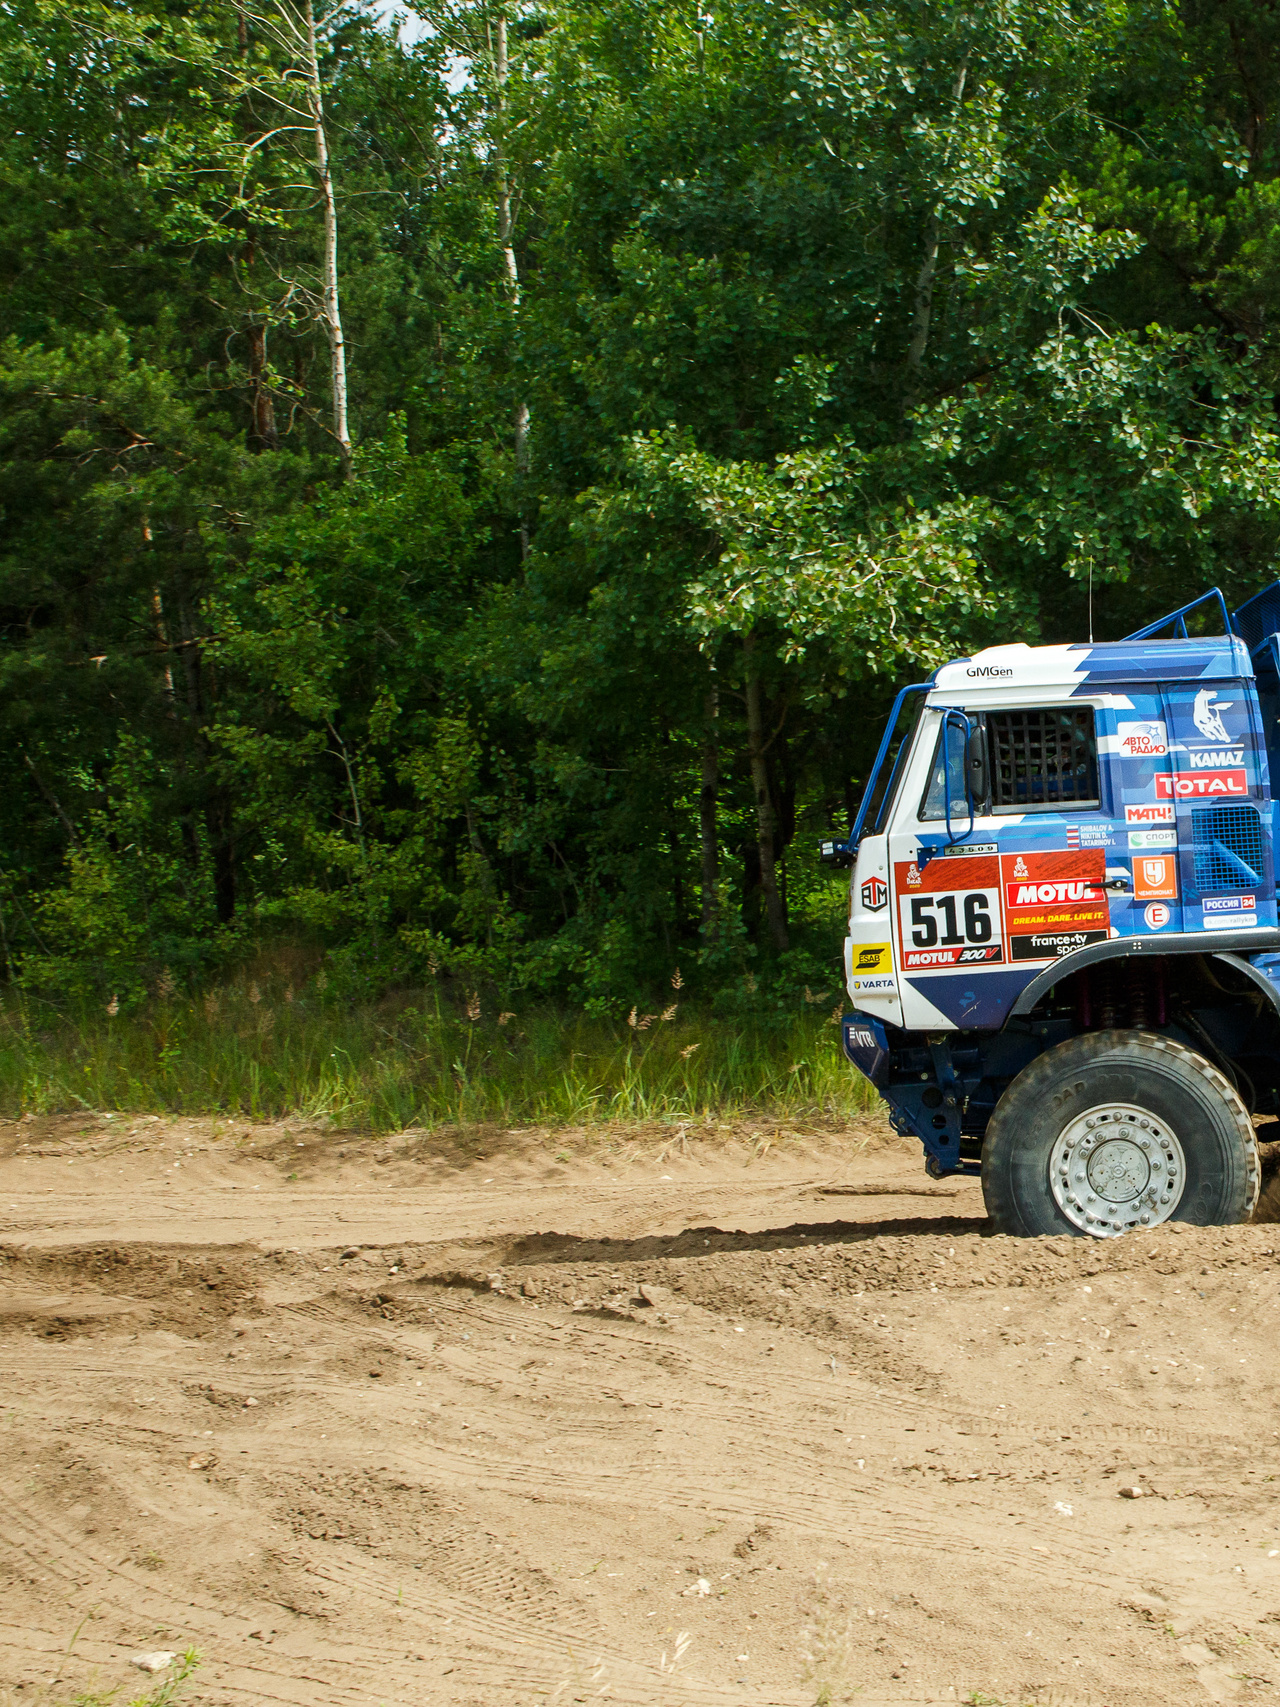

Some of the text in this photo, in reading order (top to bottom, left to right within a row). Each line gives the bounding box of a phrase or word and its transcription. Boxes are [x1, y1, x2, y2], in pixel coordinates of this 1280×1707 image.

[966, 666, 1013, 677] GMGen
[1122, 736, 1150, 746] АВТО
[1131, 744, 1166, 754] РАДИО
[1189, 750, 1245, 768] KAMAZ
[1127, 807, 1172, 821] МАТЧ!
[1016, 882, 1096, 904] MOTUL
[1206, 898, 1253, 909] РОССИЯ 24
[911, 893, 992, 948] 516
[1047, 915, 1072, 923] DARE.
[1152, 909, 1163, 922] E
[1057, 945, 1084, 955] spo
[859, 954, 880, 963] ESAB
[907, 947, 999, 965] MOTUL 300V
[862, 980, 894, 989] VARTA
[855, 1031, 875, 1047] VTB
